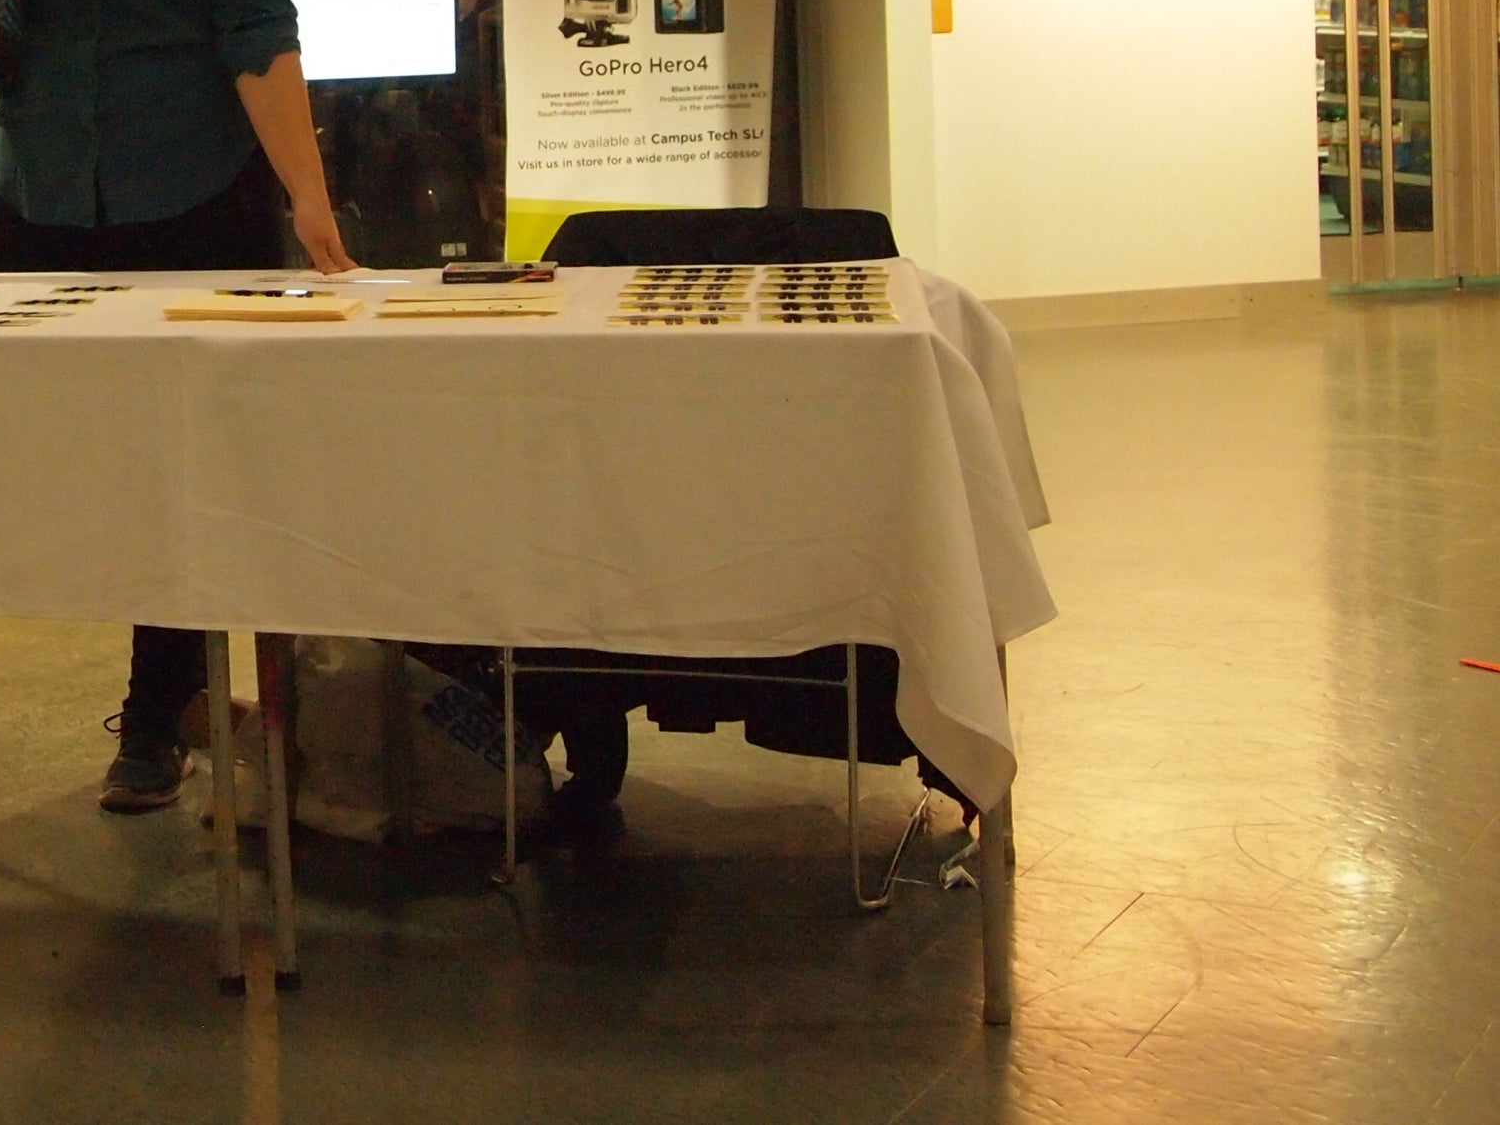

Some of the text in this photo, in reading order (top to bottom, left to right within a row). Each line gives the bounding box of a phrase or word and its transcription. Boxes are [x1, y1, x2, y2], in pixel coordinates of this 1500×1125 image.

[579, 55, 709, 76] GoPro Hero4
[563, 90, 589, 98] Edition
[538, 139, 569, 150] Now
[573, 136, 630, 149] available
[634, 135, 647, 145] at
[651, 133, 703, 145] Campus
[707, 129, 738, 141] Tech
[518, 160, 542, 170] Visit
[546, 159, 559, 168] us
[562, 157, 573, 167] in
[576, 156, 603, 167] store
[607, 155, 622, 165] for
[626, 156, 632, 164] a
[636, 152, 662, 163] wide
[665, 152, 696, 163] range
[699, 151, 710, 160] of
